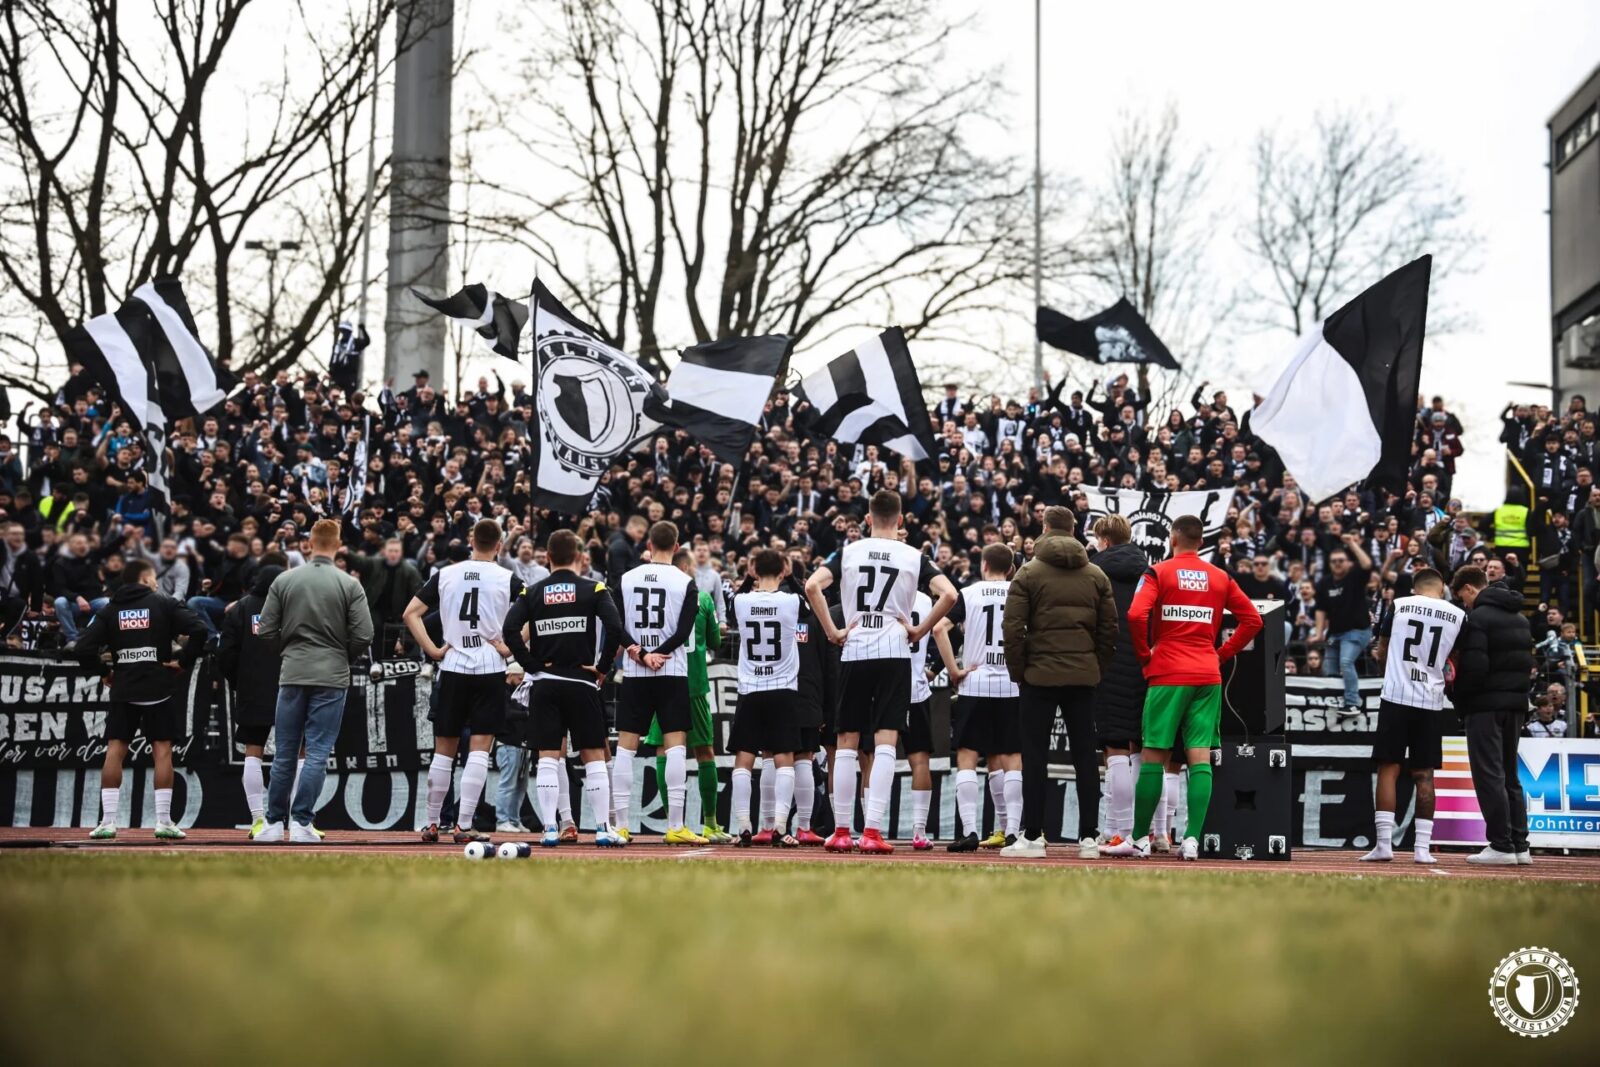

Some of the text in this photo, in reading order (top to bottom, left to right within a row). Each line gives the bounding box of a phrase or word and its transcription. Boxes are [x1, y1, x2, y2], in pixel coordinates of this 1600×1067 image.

[868, 551, 891, 561] KOLBE
[464, 572, 481, 581] GAAL
[1179, 570, 1207, 580] LIQUI
[545, 583, 575, 594] LIQUI
[857, 566, 900, 612] 27
[1180, 580, 1207, 590] MOLY
[546, 593, 576, 603] MOLY
[459, 587, 480, 629] 4
[633, 586, 666, 629] 33
[750, 606, 778, 616] BRANDT
[1163, 606, 1212, 620] uhlsport
[120, 610, 148, 620] LIQUI
[1400, 605, 1458, 624] BATISTA MEIER
[121, 619, 149, 629] MOLY
[537, 618, 586, 632] uhlsport
[862, 614, 883, 629] ULM
[462, 635, 482, 649] ULM
[640, 634, 660, 647] ULM
[745, 620, 782, 661] 23
[1403, 618, 1443, 668] 21
